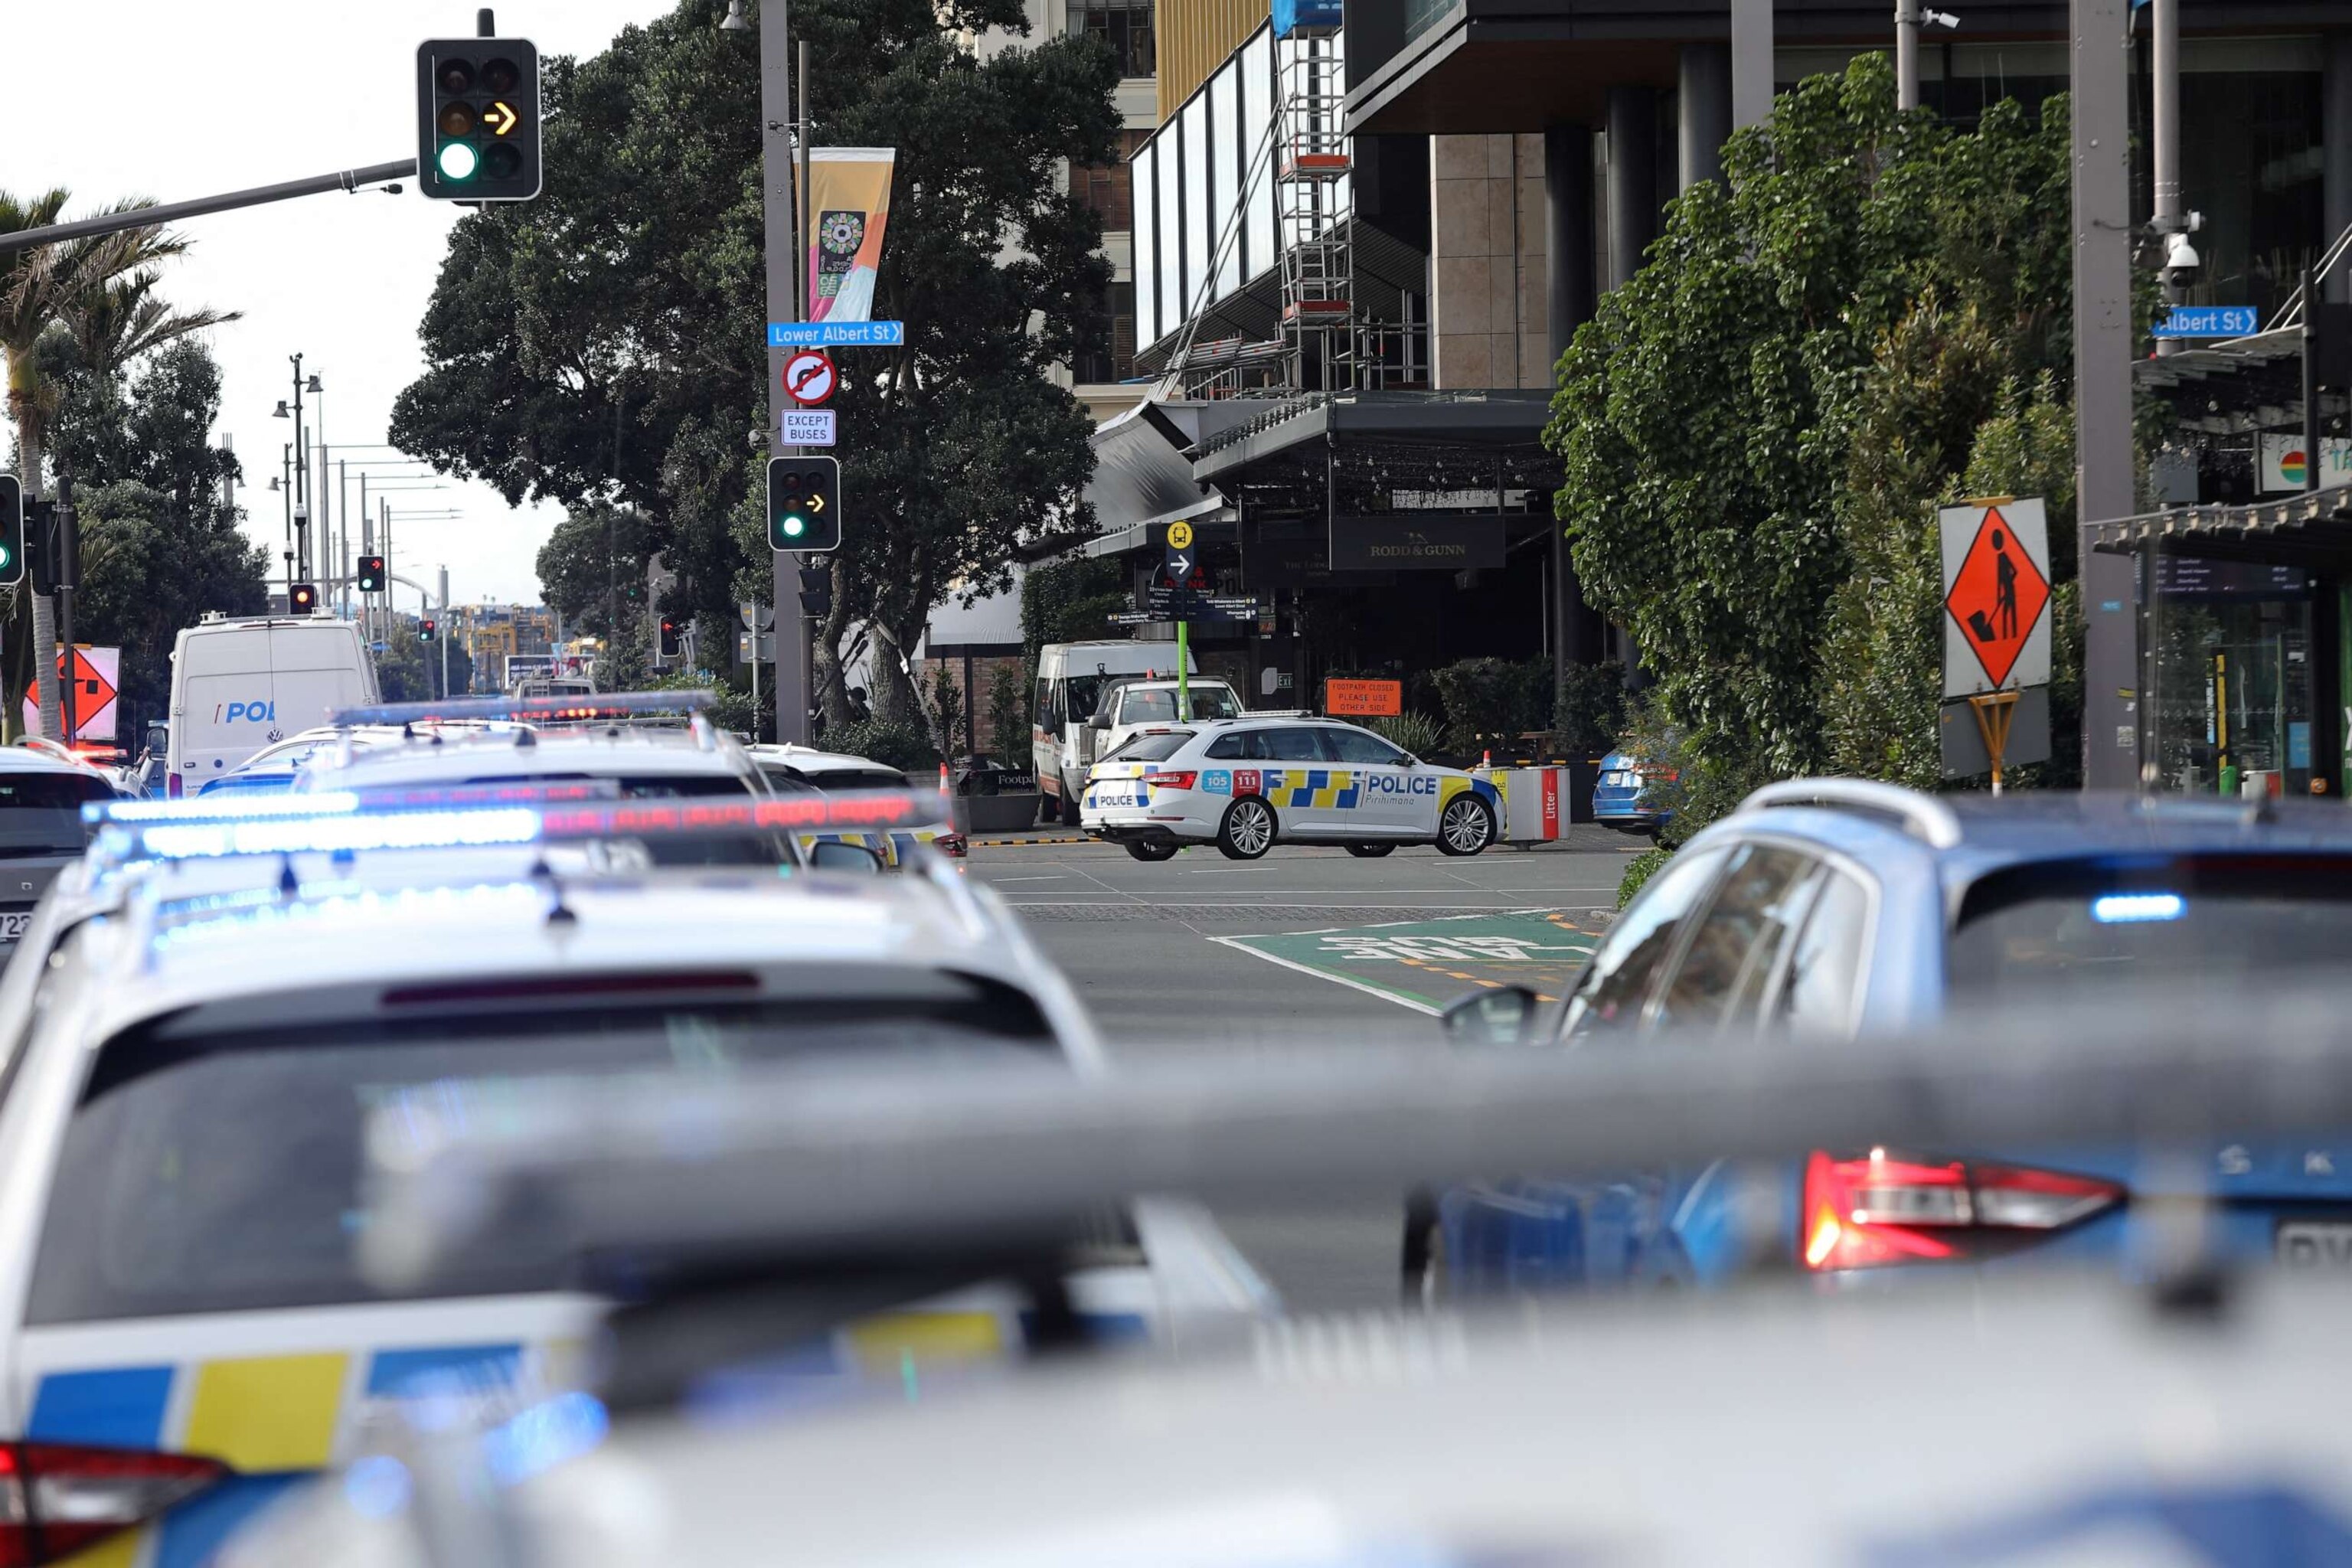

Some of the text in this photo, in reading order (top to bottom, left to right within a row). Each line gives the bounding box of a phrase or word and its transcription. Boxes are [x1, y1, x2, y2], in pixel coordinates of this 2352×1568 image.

[2159, 311, 2243, 331] Albert St
[776, 325, 890, 342] Lower Albert St
[788, 416, 830, 426] EXCEPT
[790, 430, 827, 439] BUSES
[1338, 693, 1369, 701] PLEASE
[1207, 776, 1227, 786] 105
[1237, 776, 1256, 786] 111
[1367, 774, 1437, 795] POLICE
[1100, 794, 1133, 806] POLICE
[1365, 793, 1415, 805] Pirihimana
[1546, 791, 1556, 819] Litter
